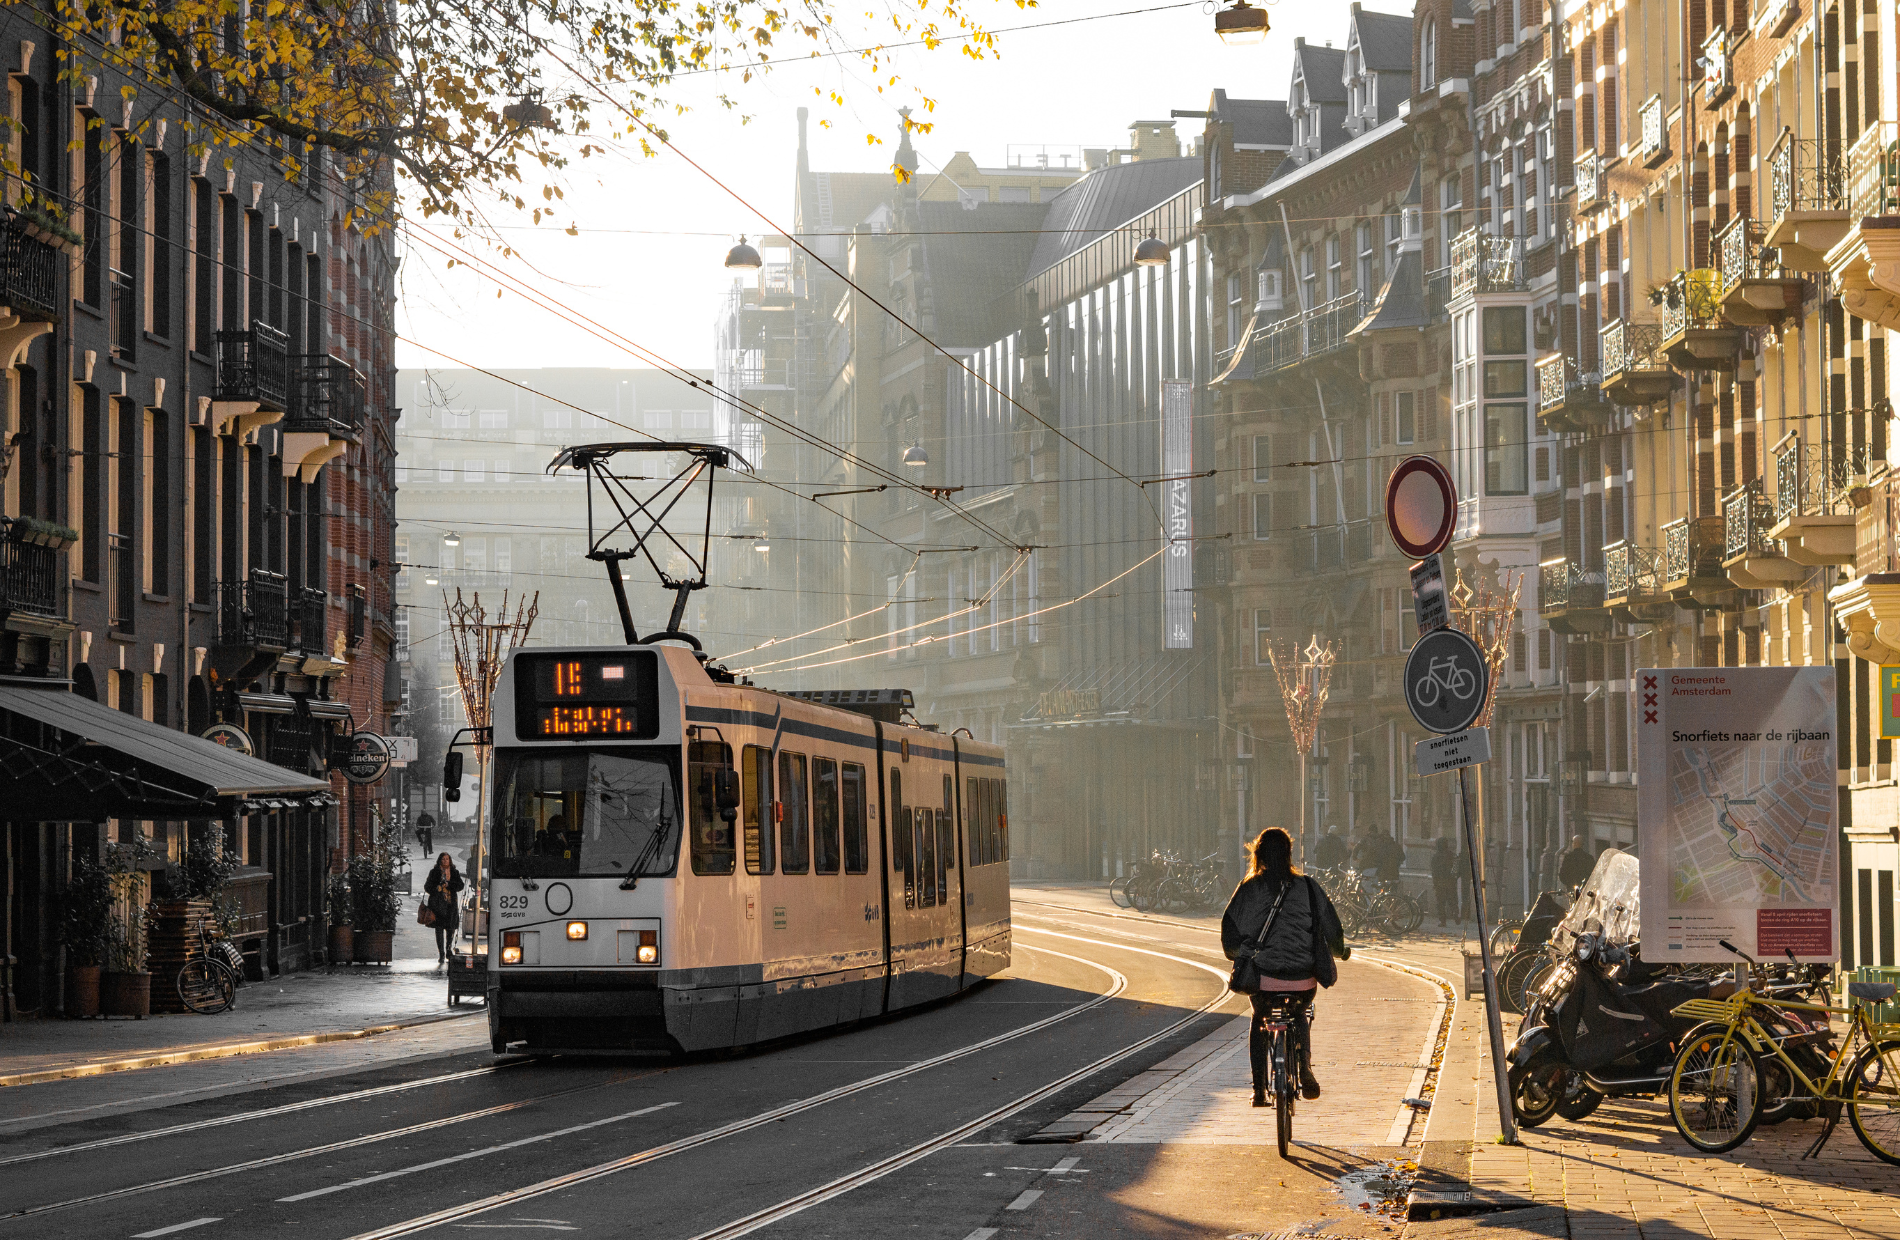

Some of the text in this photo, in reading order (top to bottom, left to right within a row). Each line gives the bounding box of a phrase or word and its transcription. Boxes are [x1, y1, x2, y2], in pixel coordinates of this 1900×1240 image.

[1671, 675, 1726, 684] Gemeente
[1671, 686, 1731, 696] Amsterdam
[1430, 735, 1469, 750] snorfietsen
[1672, 729, 1830, 744] Snorfiets naar de rijbaan
[349, 753, 386, 763] eineken
[1444, 747, 1459, 757] niet
[1434, 756, 1472, 770] toegestaan
[499, 895, 529, 909] 829
